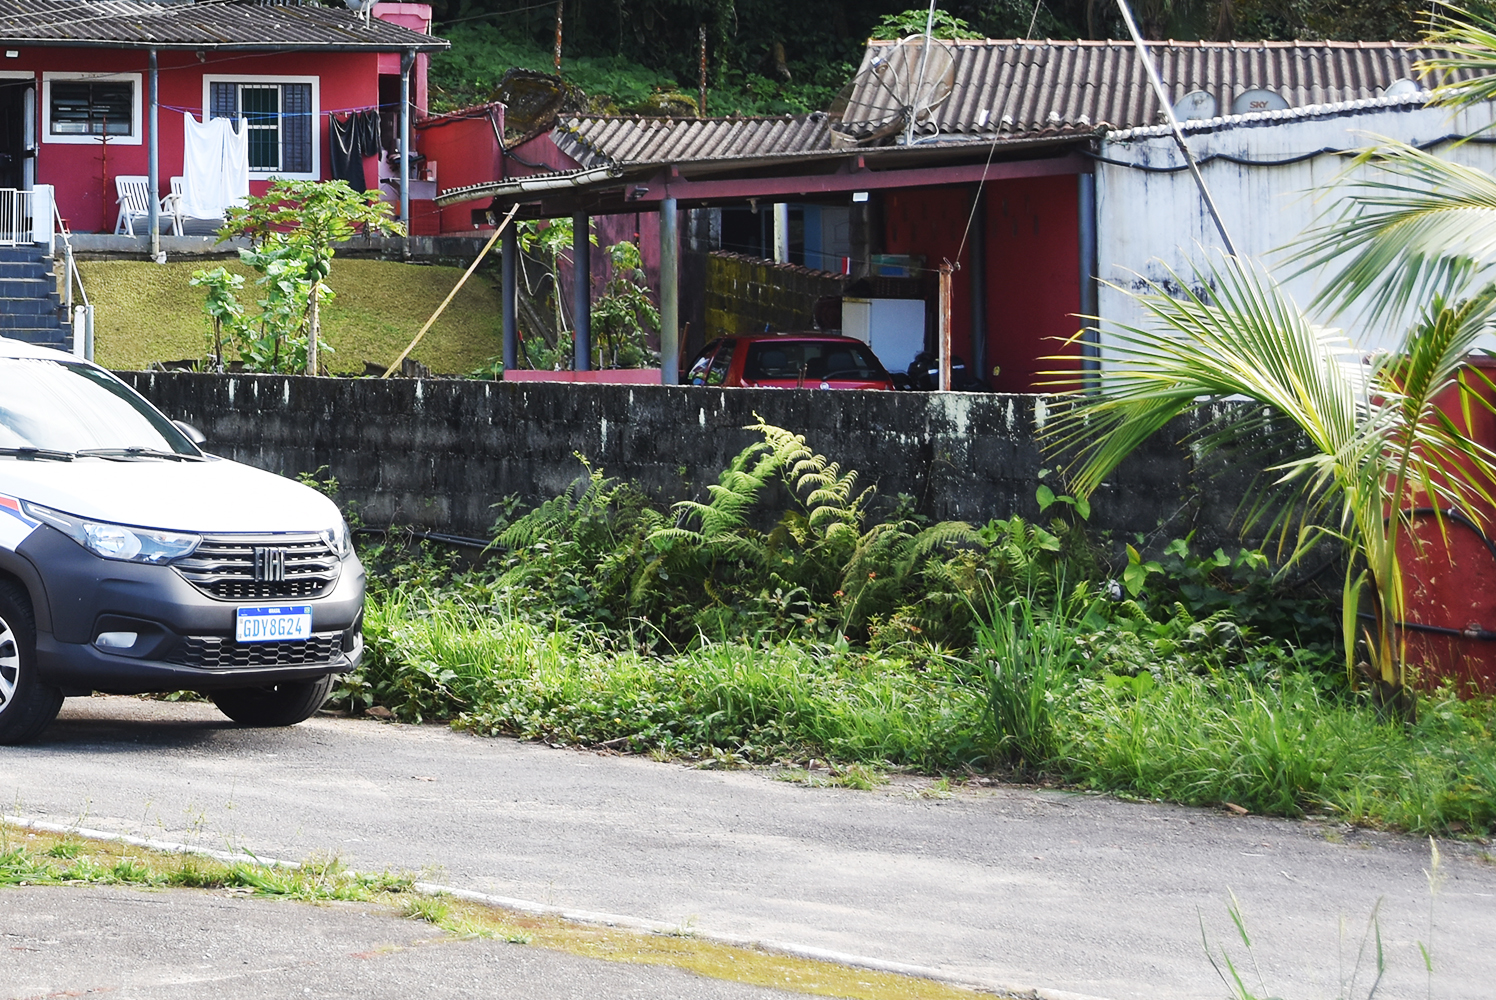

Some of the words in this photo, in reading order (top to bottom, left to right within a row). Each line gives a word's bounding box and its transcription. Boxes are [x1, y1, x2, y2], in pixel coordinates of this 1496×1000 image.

[1249, 100, 1269, 109] SKY
[255, 546, 287, 582] FIAT
[243, 617, 302, 638] GDY8G24
